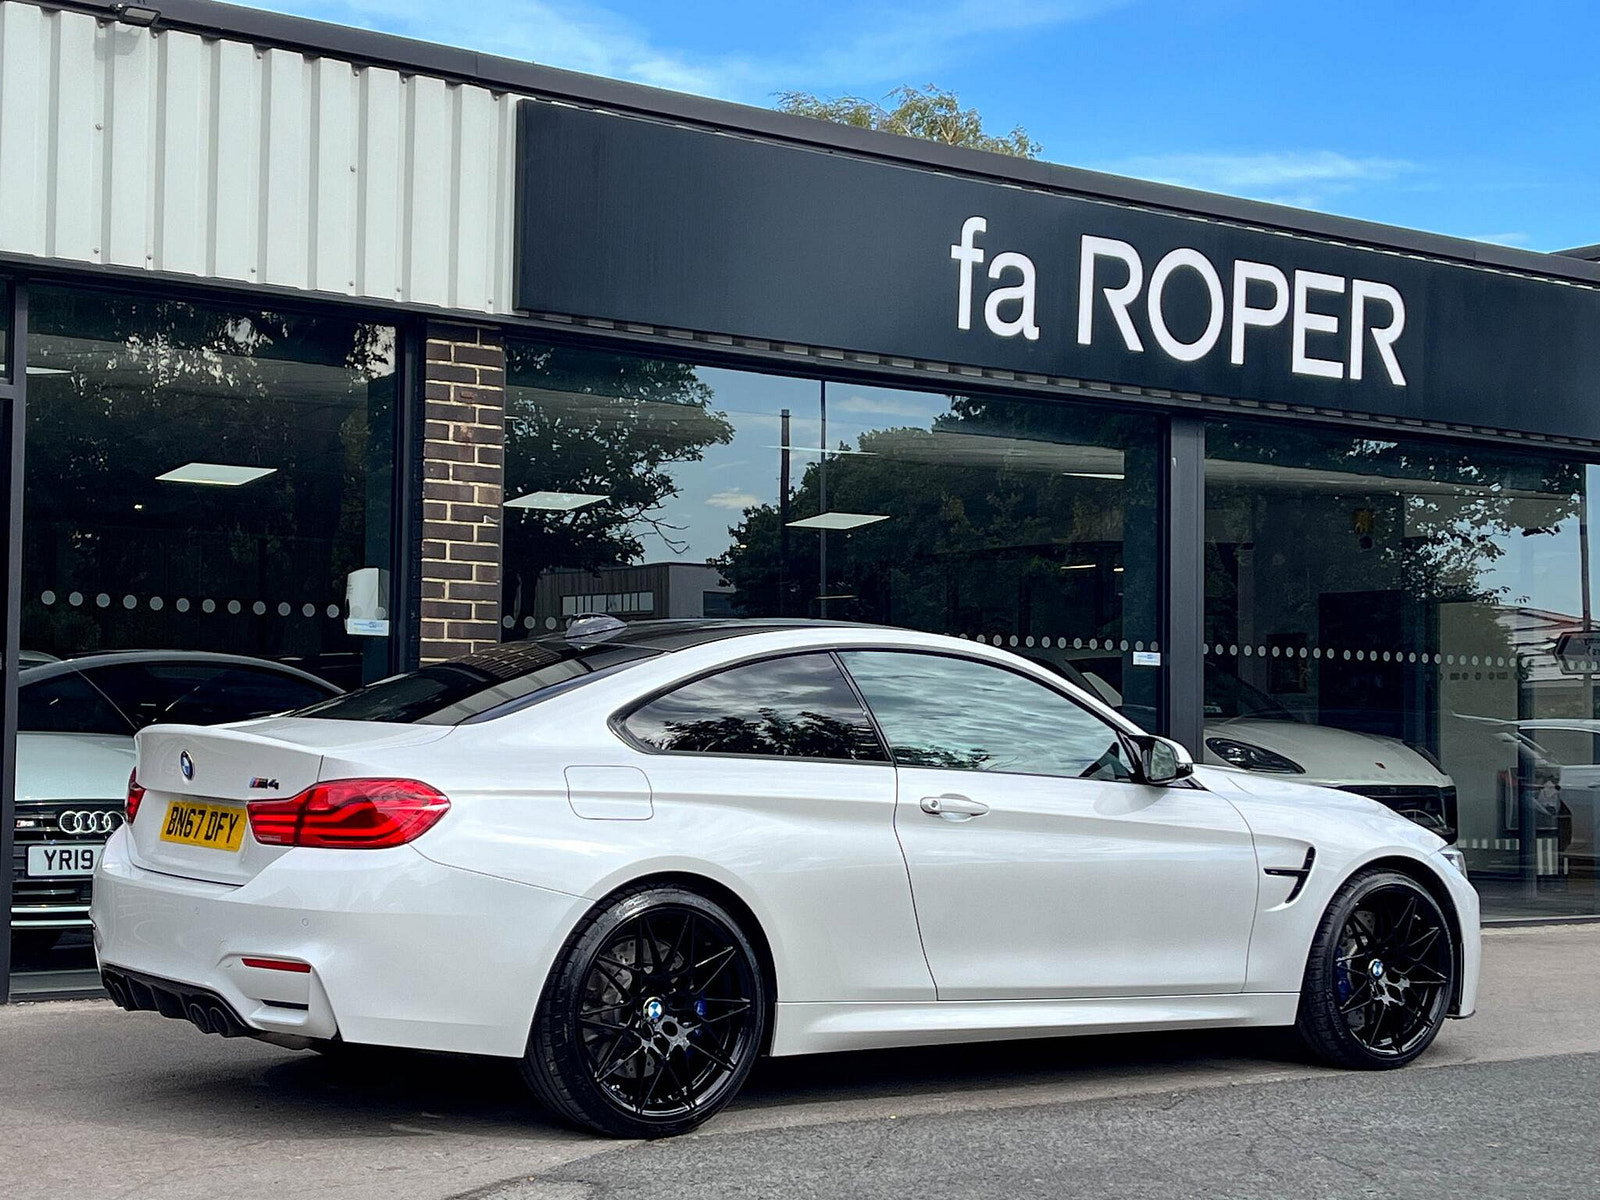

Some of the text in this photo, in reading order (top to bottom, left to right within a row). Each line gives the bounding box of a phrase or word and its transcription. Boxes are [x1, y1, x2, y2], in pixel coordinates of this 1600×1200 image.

[950, 216, 1407, 387] fa ROPER
[166, 806, 239, 843] BN67 DFY
[44, 849, 94, 870] YR19
